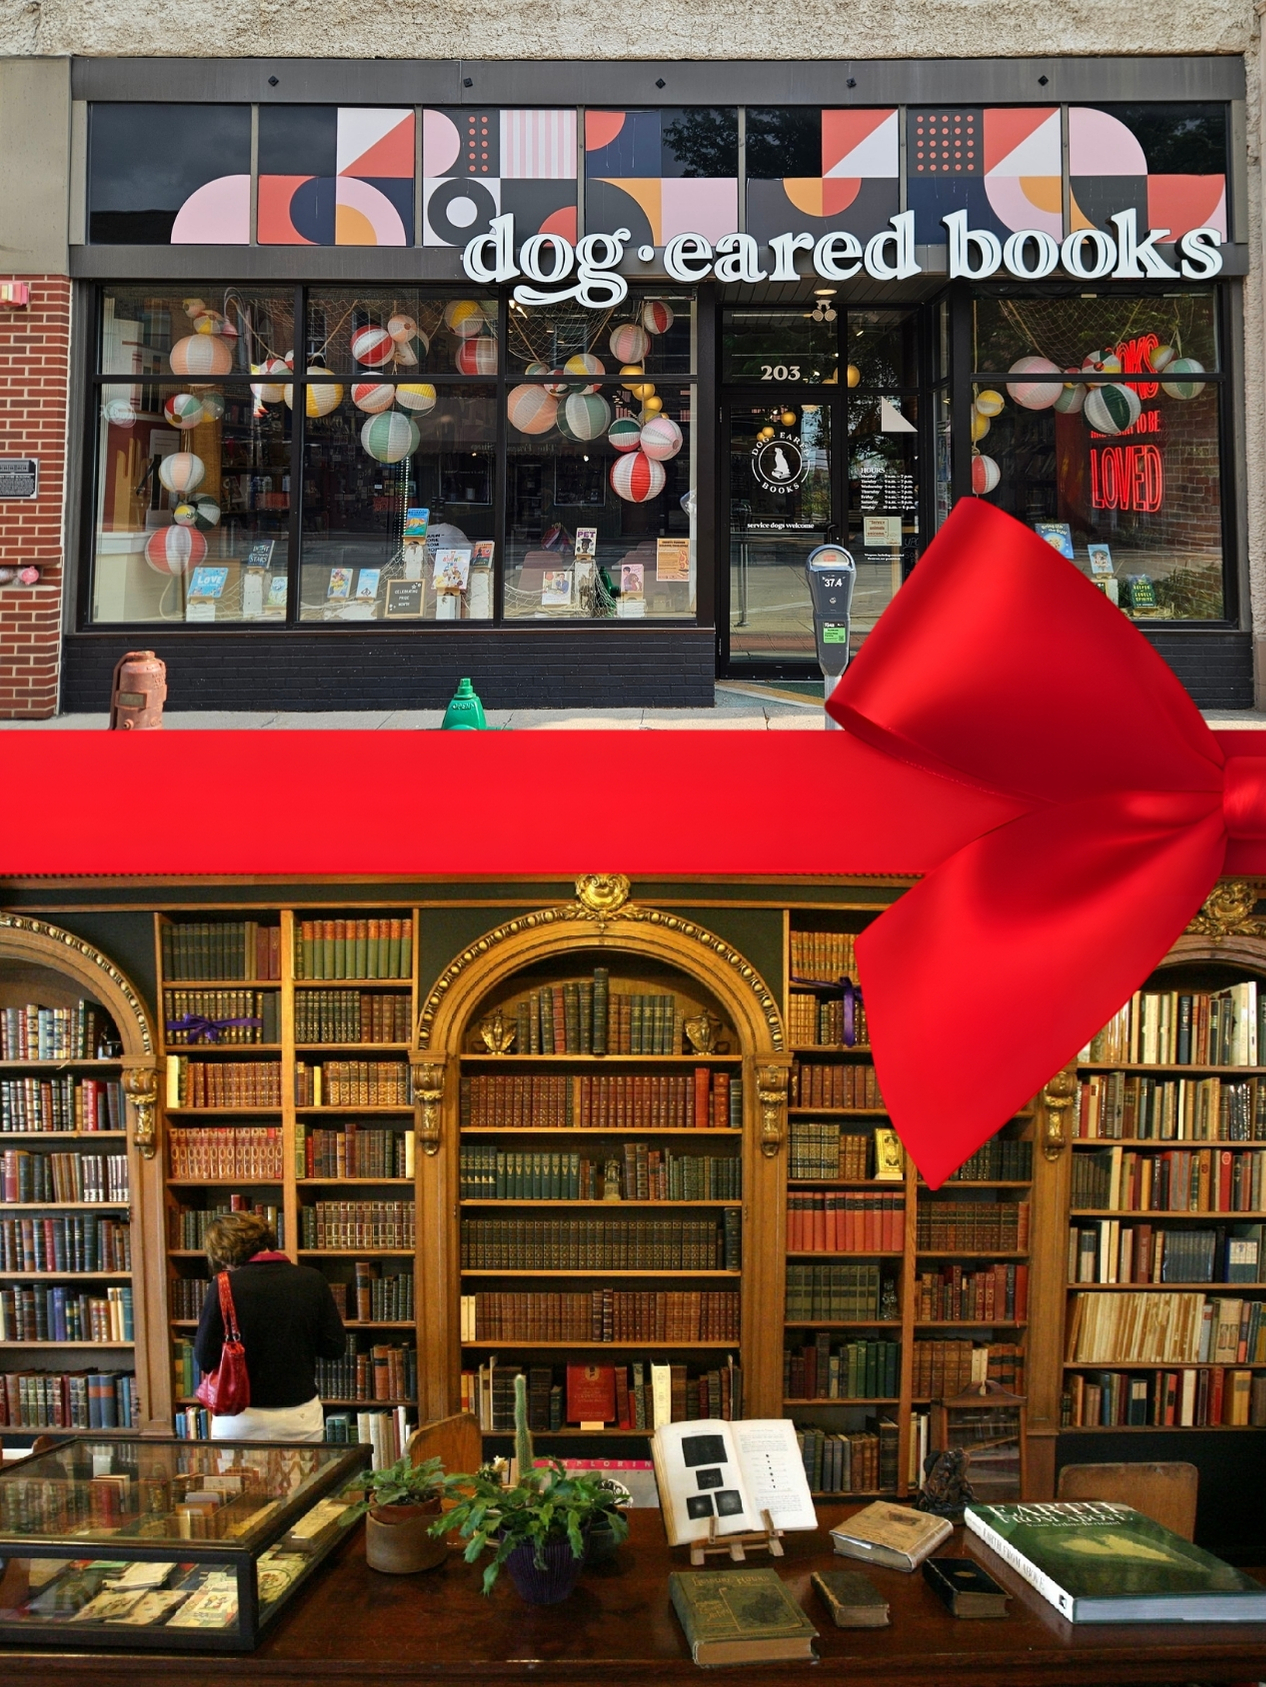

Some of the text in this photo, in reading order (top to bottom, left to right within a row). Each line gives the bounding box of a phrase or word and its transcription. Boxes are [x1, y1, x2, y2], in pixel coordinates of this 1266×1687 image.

[941, 208, 1224, 281] books
[761, 365, 801, 380] 203
[1148, 410, 1161, 433] BE
[1091, 445, 1163, 512] LOVED
[762, 482, 800, 494] BOOKS
[770, 523, 785, 531] dogs
[198, 576, 222, 584] LOVE
[985, 1503, 1121, 1517] EARTH
